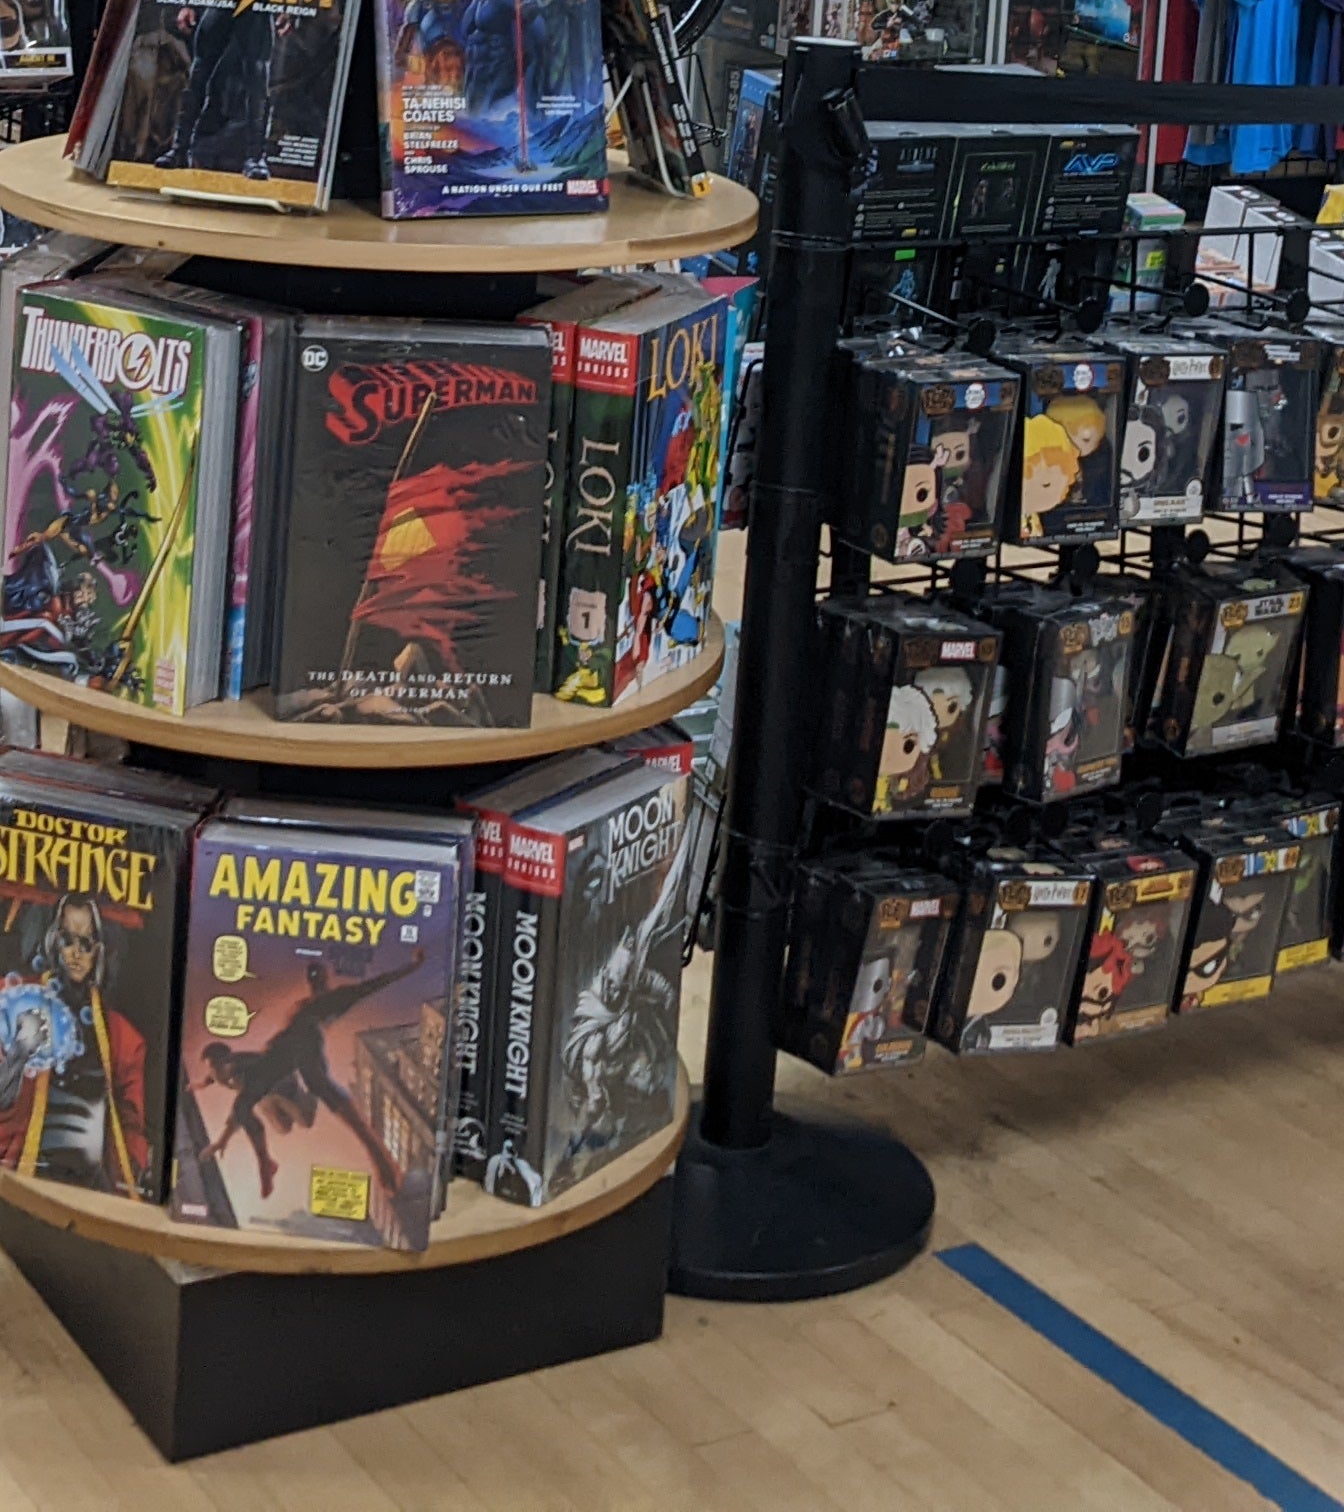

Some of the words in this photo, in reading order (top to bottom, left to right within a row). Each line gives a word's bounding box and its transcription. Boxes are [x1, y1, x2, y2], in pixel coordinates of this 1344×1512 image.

[252, 2, 284, 13] BLACK
[285, 5, 317, 17] REIGN
[402, 97, 466, 111] TA-NEHISI
[402, 110, 455, 123] COATES
[404, 140, 458, 149] STELFREEZE
[404, 156, 433, 165] CHRIS
[405, 164, 448, 174] SPROUSE
[1063, 153, 1122, 174] AVP
[451, 185, 486, 194] NATION
[488, 184, 519, 194] UNDER
[542, 182, 564, 193] FEET
[567, 180, 599, 195] MARVEL
[302, 345, 329, 372] DC
[579, 336, 628, 364] MARVEL
[646, 314, 718, 402] LOKI
[326, 360, 538, 445] SUPERMAN
[566, 437, 621, 556] LOKI
[581, 611, 590, 630] 1
[940, 640, 976, 660] MARVEL
[308, 670, 336, 681] THE
[340, 669, 402, 683] DEATH
[408, 673, 437, 684] AND
[442, 671, 513, 686] RETURN
[349, 687, 367, 698] OF
[373, 686, 470, 699] SUPERMAN
[13, 807, 128, 847] DOCTOR
[607, 789, 676, 847] MOON
[510, 834, 555, 865] MARVEL
[607, 819, 682, 905] KNIGHT
[209, 853, 420, 917] AMAZING
[909, 898, 941, 917] MARVEL
[236, 905, 386, 947] FANTASY
[461, 892, 486, 977] MOON
[511, 911, 538, 999] MOON
[455, 978, 483, 1076] KNIGHT
[504, 998, 536, 1100] KNIGHT
